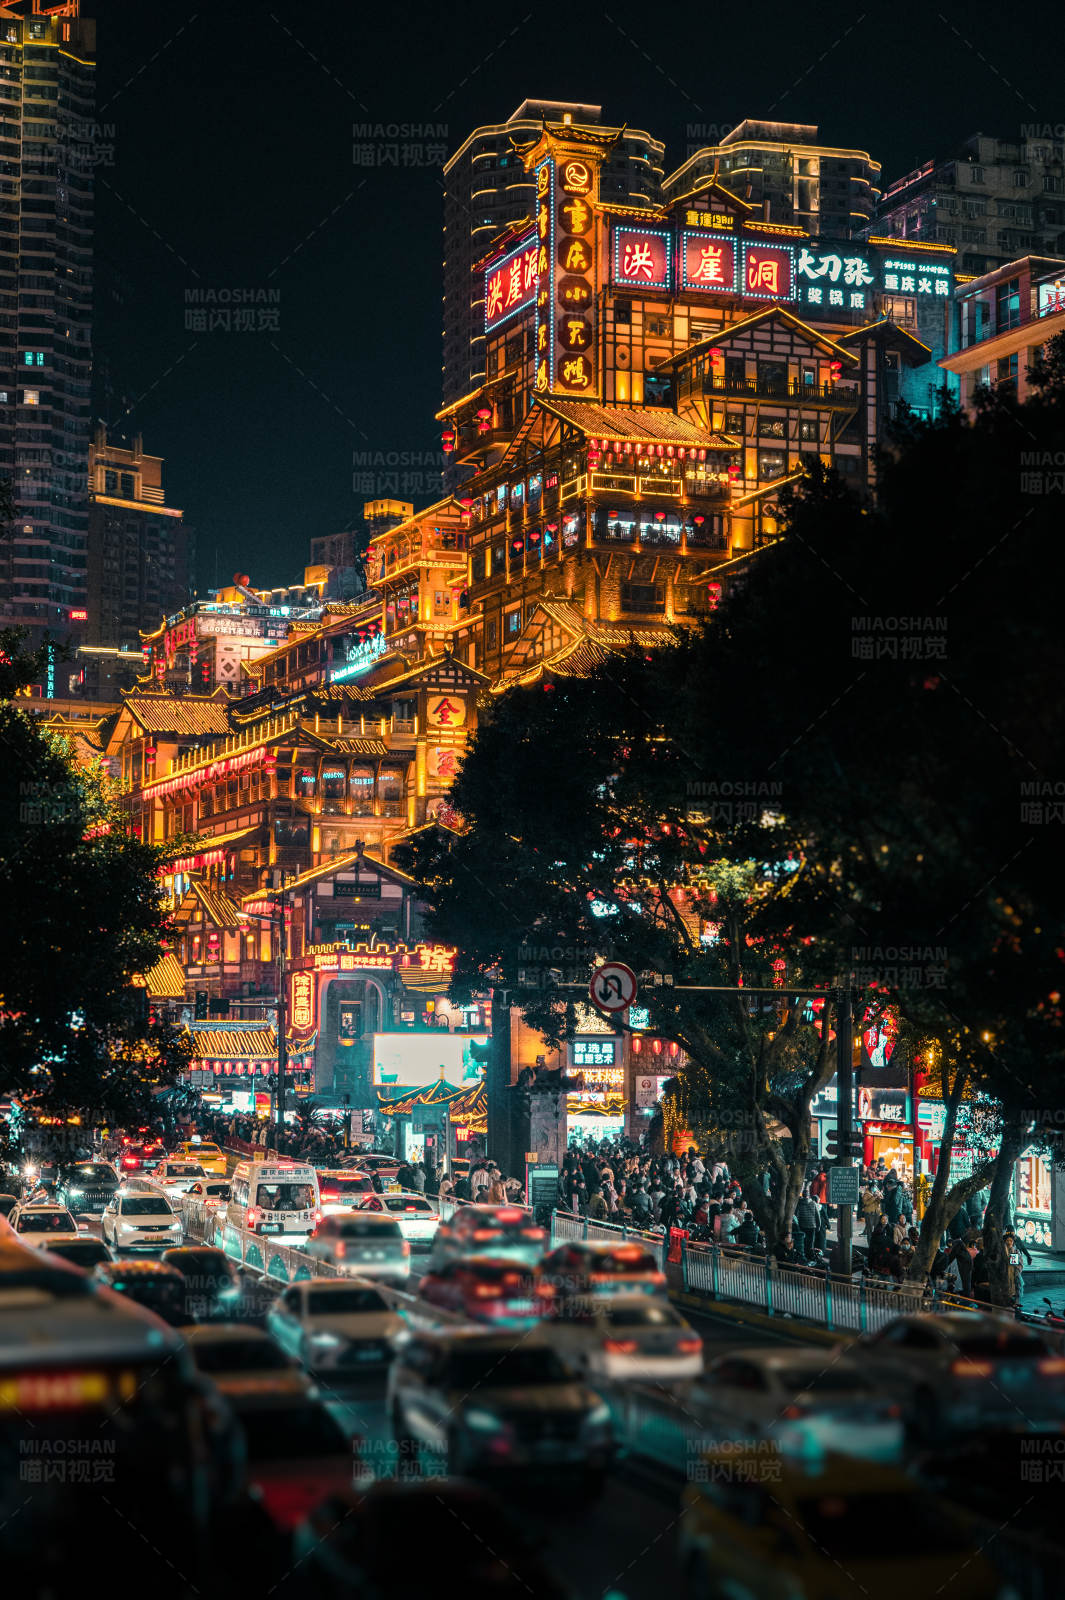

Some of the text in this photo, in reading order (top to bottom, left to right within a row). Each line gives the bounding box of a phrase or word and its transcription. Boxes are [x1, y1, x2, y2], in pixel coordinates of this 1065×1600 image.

[487, 248, 538, 320] 洪崖洞
[624, 242, 779, 293] 洪崖洞
[799, 249, 874, 287] 大刀张
[885, 274, 950, 296] 重庆火锅
[563, 199, 589, 388] 重庆小天鹅
[799, 288, 865, 309] 奖锅底
